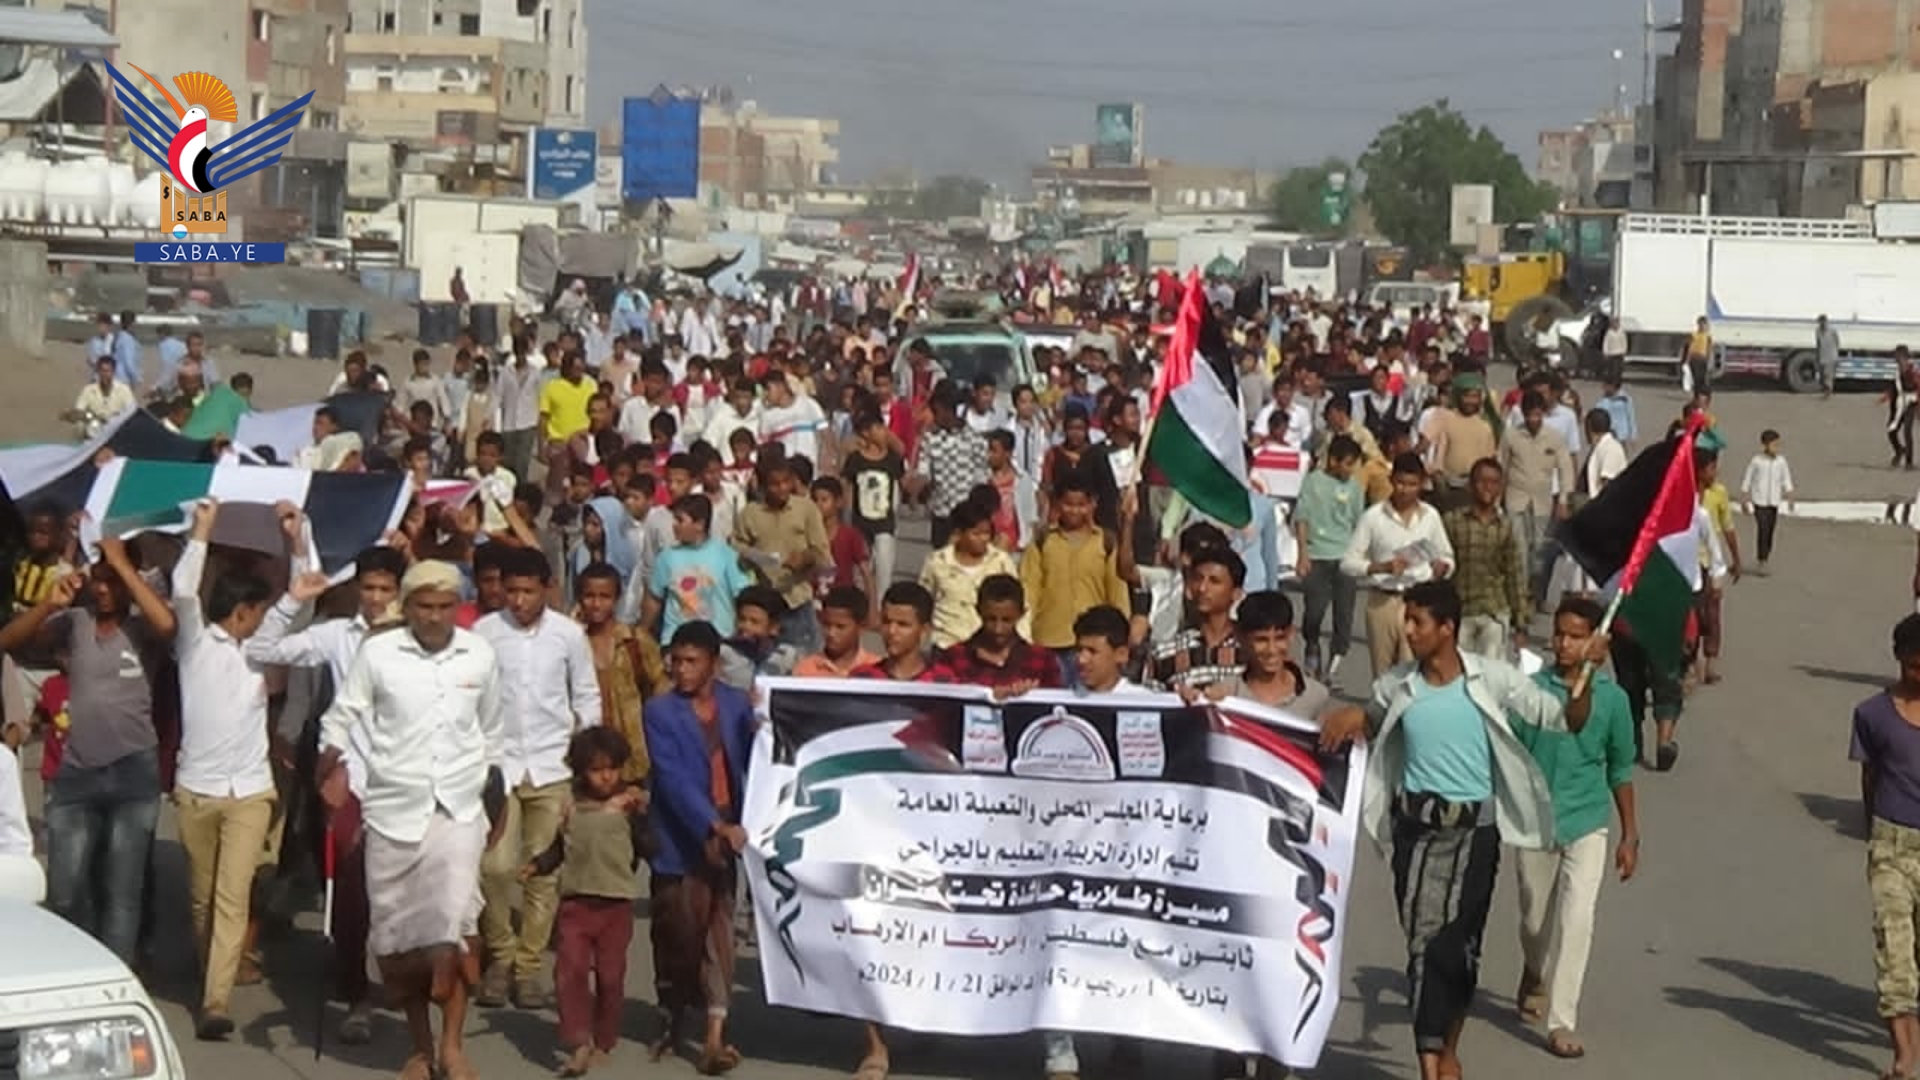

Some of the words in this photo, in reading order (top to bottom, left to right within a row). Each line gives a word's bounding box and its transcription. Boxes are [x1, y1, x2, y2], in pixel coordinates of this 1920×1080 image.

[897, 788, 959, 812] العامة
[1152, 798, 1209, 834] برعاية
[945, 878, 1005, 907] تحت
[1067, 879, 1151, 910] طلابية
[1153, 887, 1231, 925] مسيرة
[1133, 938, 1175, 961] مع
[1179, 942, 1254, 970] ثابتون
